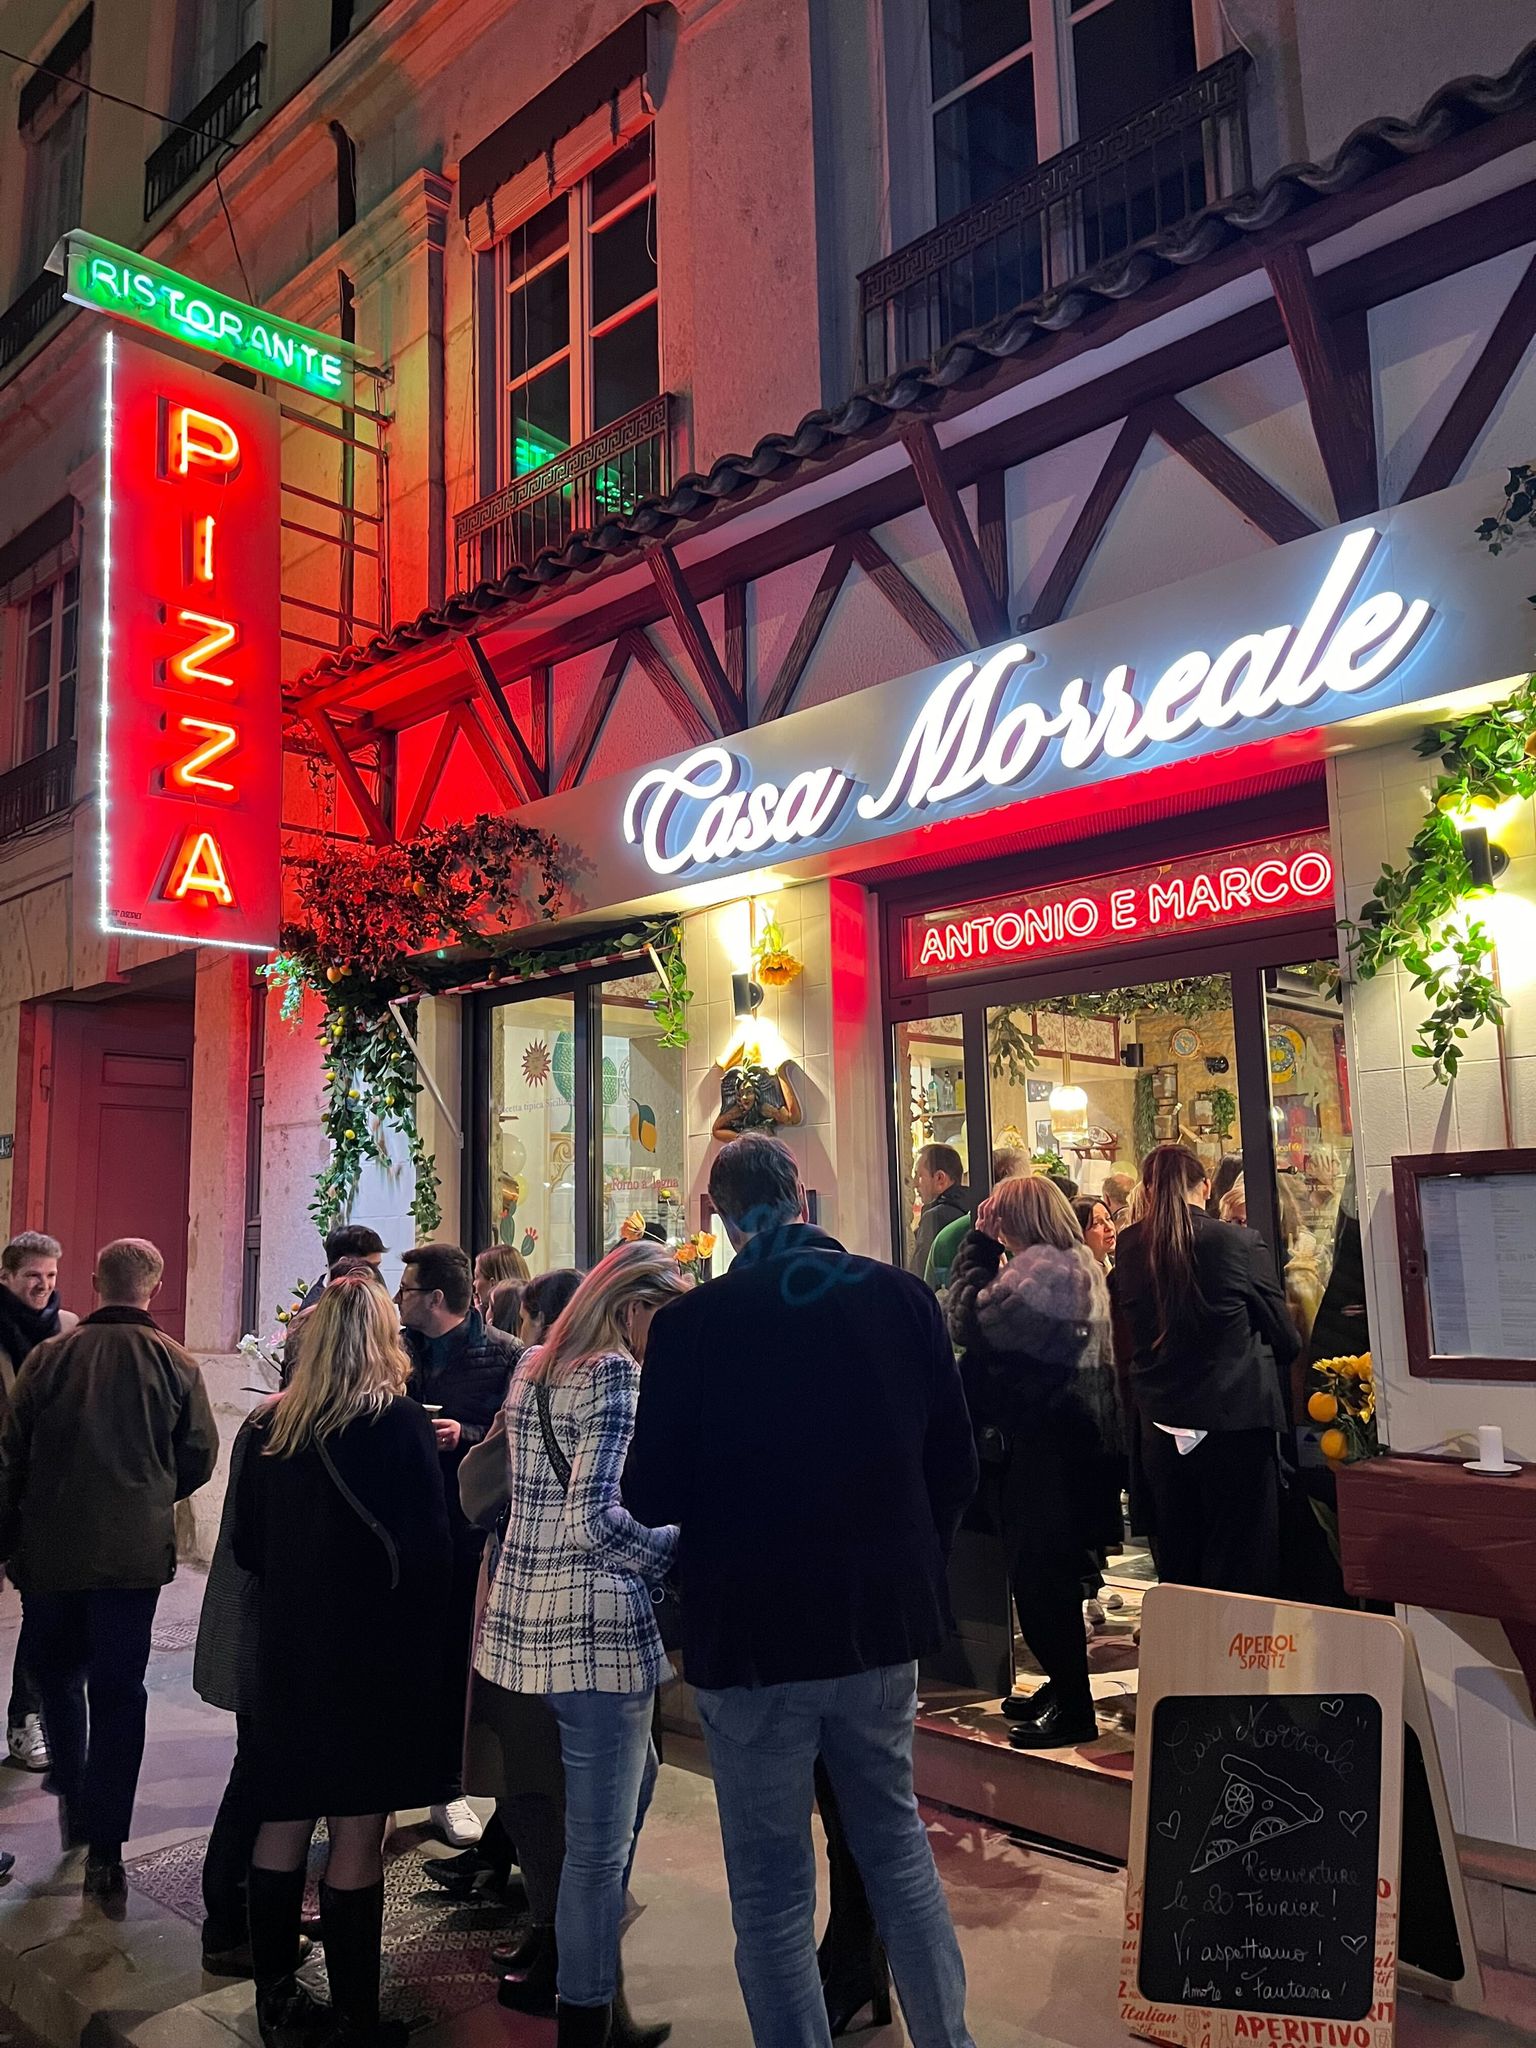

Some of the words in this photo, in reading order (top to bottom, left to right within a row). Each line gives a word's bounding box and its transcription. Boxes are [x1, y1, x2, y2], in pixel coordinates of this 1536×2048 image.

[91, 259, 341, 386] RISTORANTE
[169, 404, 240, 910] PIZZA
[623, 746, 846, 874] Casa
[858, 527, 1429, 818] Morreale
[920, 898, 1098, 964] ANTONIO
[1111, 888, 1137, 931] E
[1148, 852, 1331, 924] MARCO
[1229, 1633, 1297, 1657] APEROL
[1240, 1654, 1285, 1670] SPRITZ
[1121, 2003, 1177, 2024] Italian
[1234, 2014, 1371, 2048] APERITIVO
